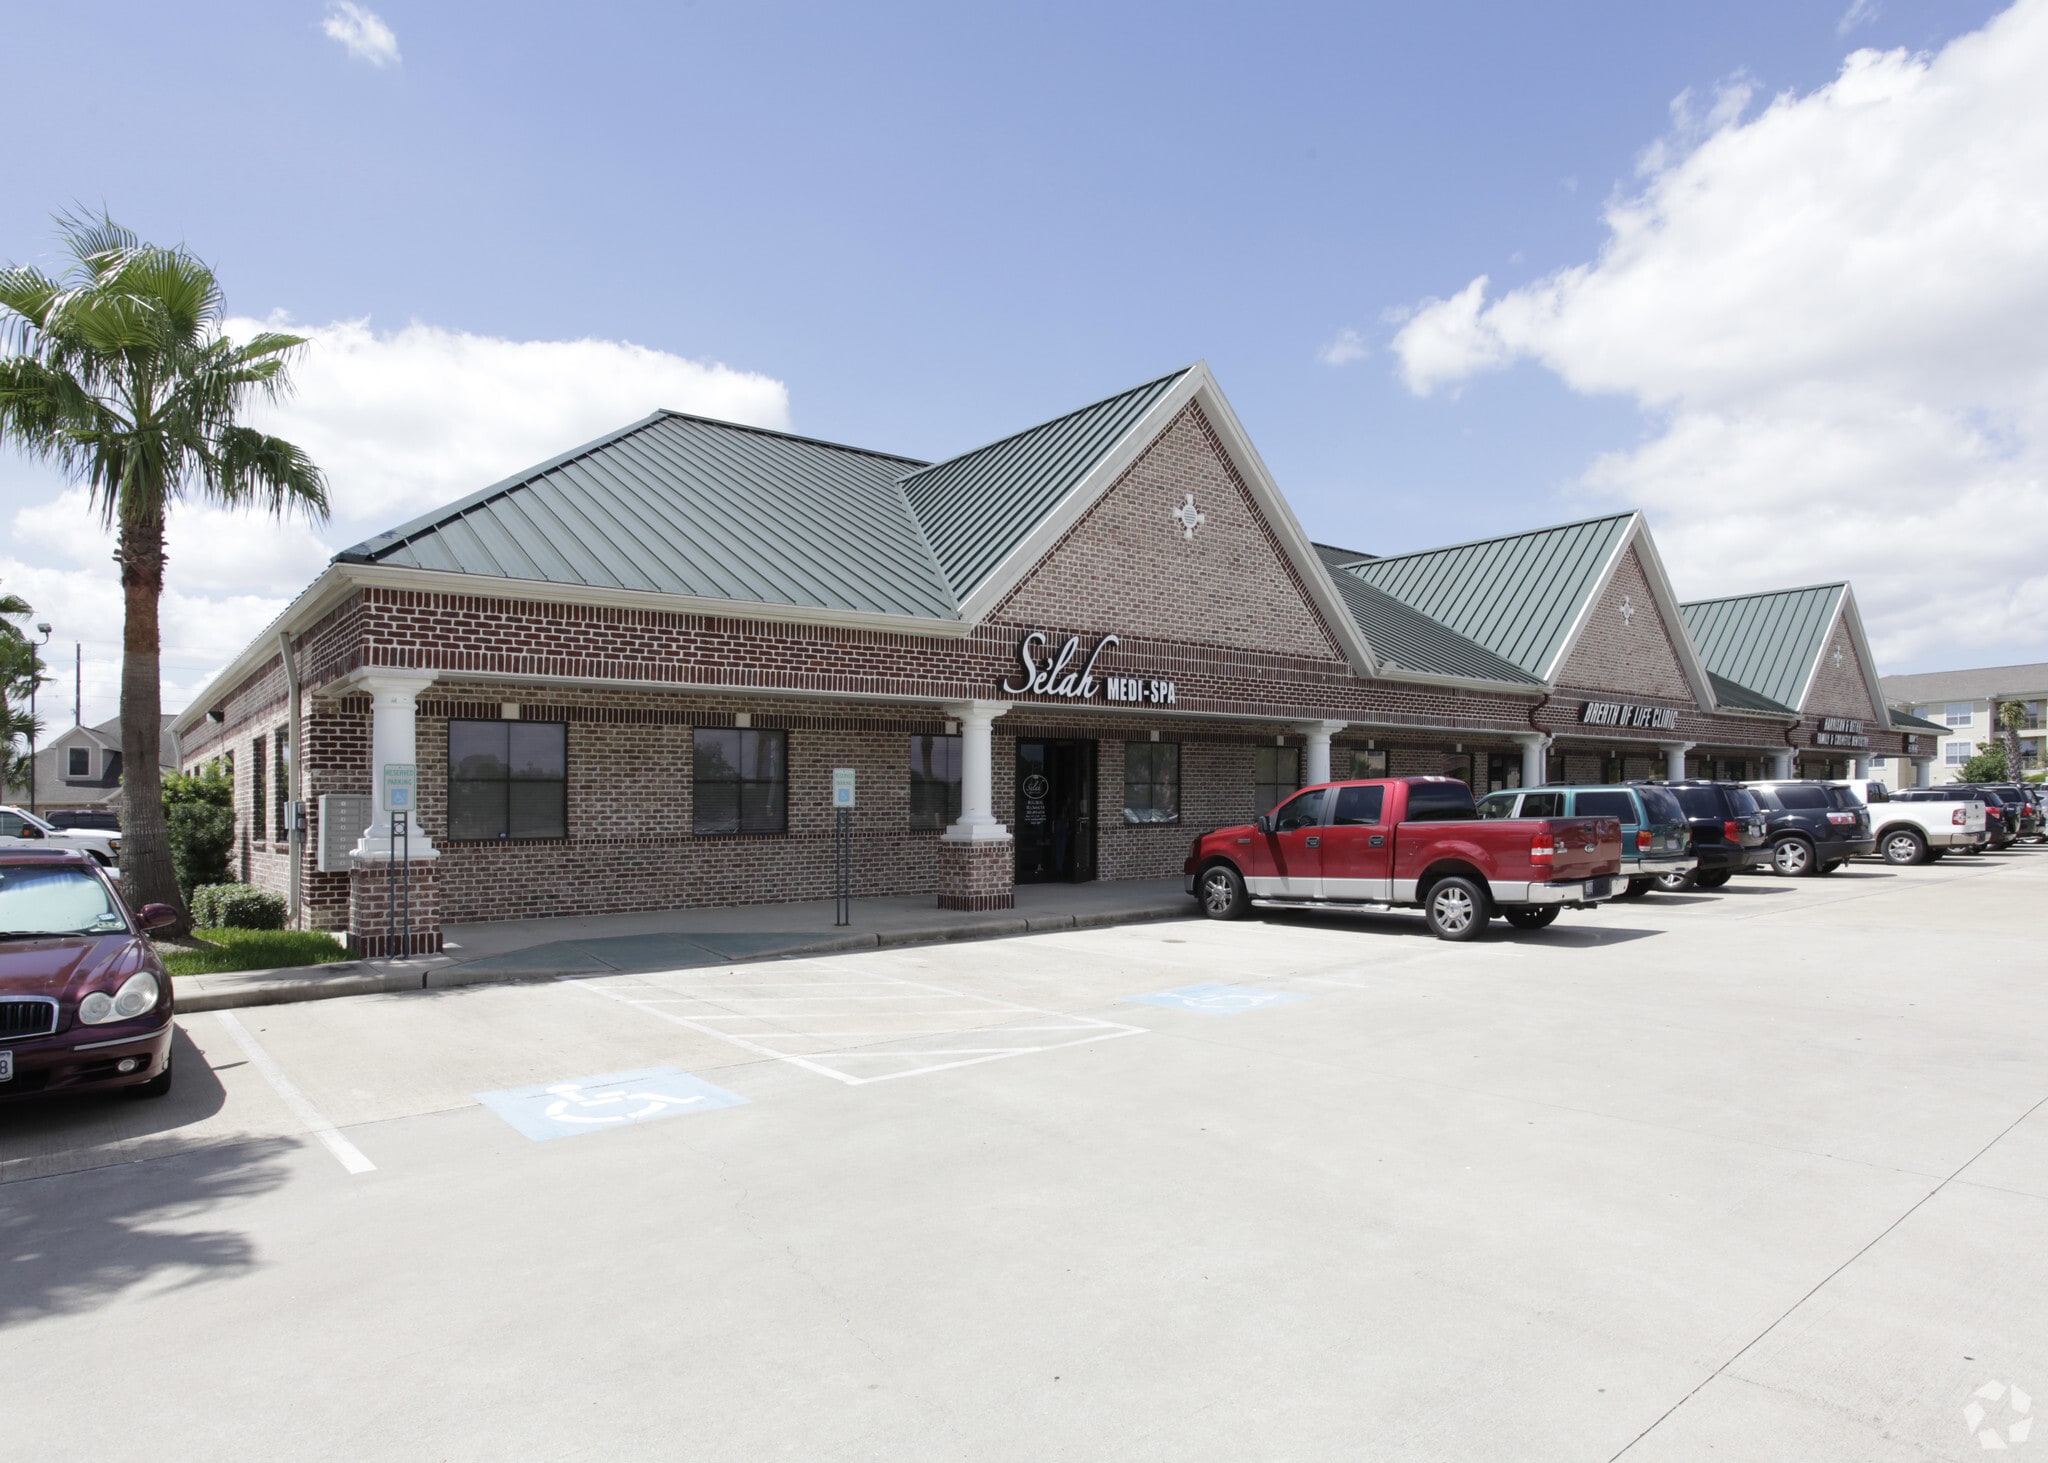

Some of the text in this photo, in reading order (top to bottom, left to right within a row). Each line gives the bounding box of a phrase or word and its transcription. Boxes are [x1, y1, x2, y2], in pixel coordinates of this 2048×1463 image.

[1107, 677, 1176, 704] MEDI-SPA
[1583, 702, 1679, 729] BREATH OF LIFE CLINIC
